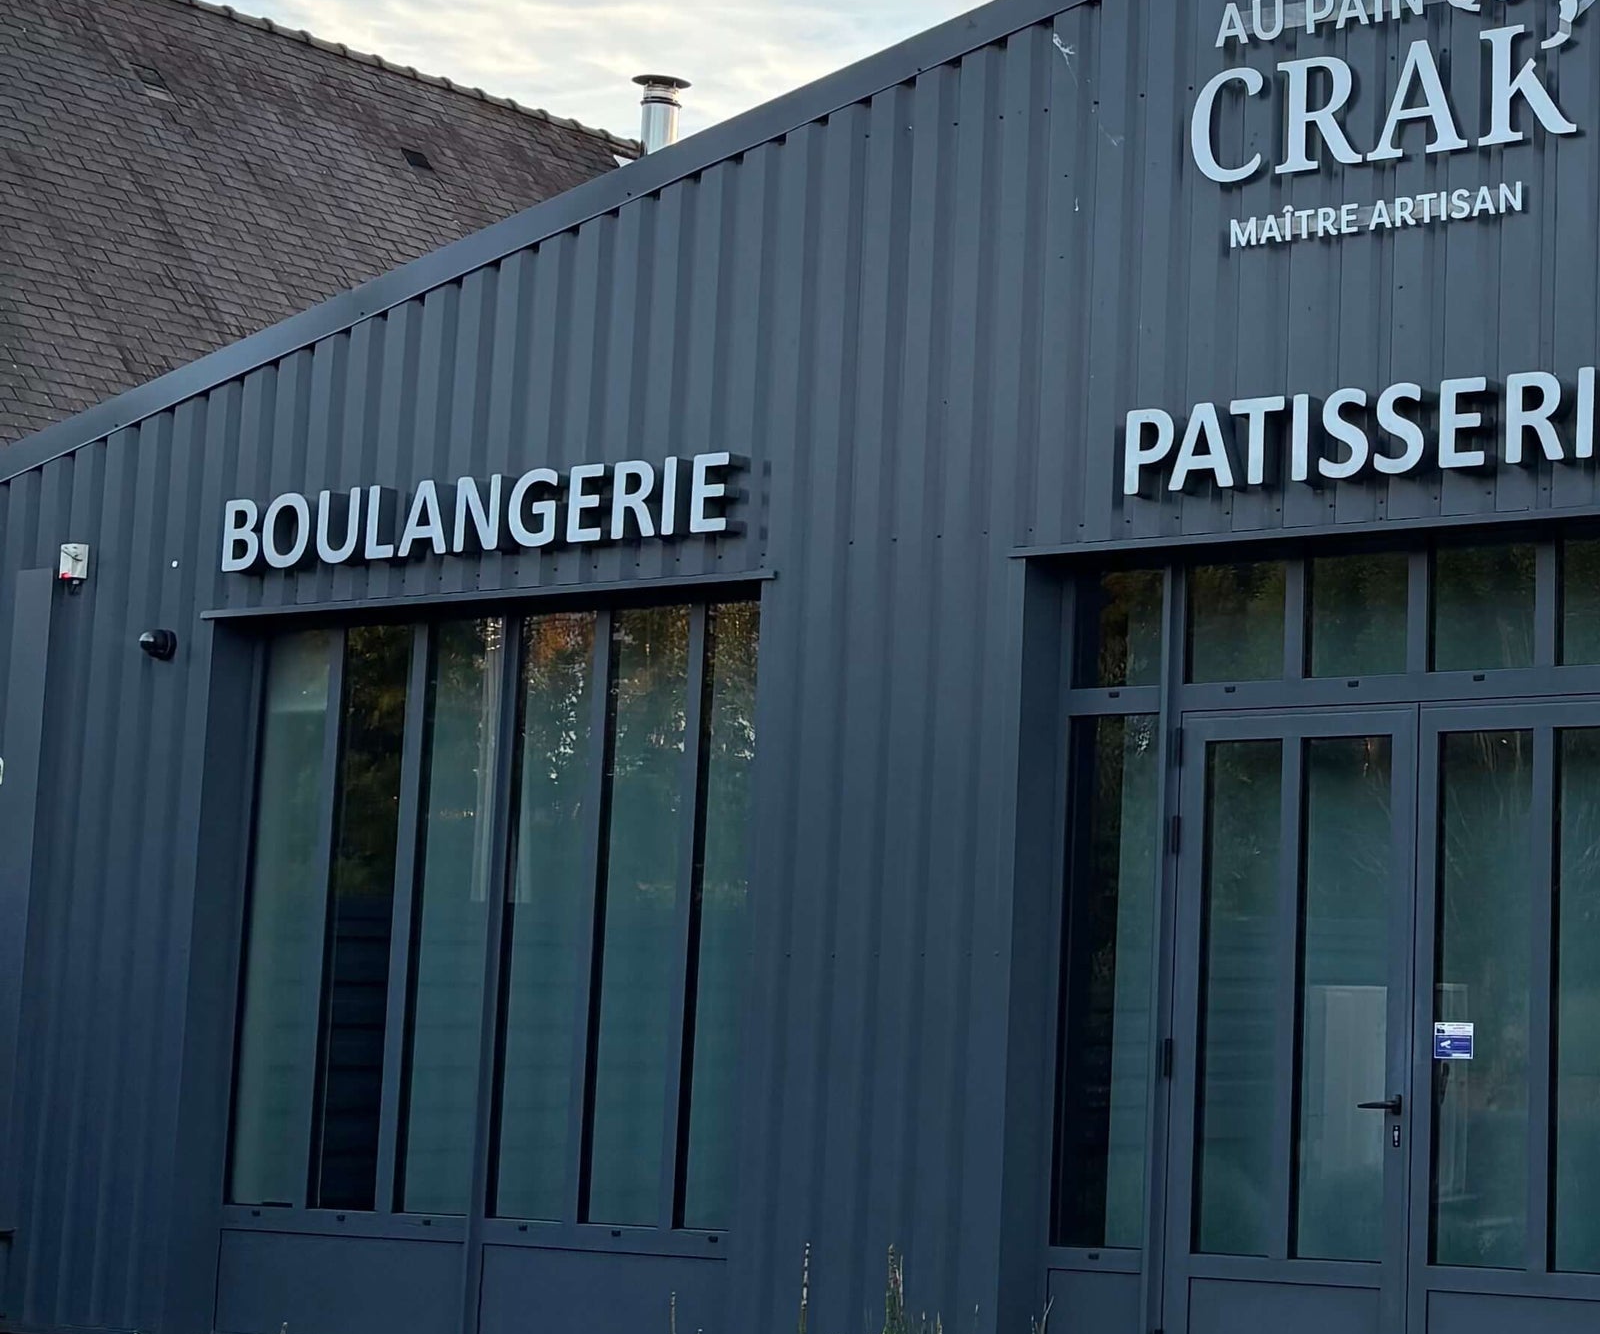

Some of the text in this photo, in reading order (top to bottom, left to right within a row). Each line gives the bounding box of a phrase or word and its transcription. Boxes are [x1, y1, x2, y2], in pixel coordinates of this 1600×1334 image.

[1229, 180, 1523, 248] MAÎTRE ARTISAN
[221, 452, 730, 572] BOULANGERIE
